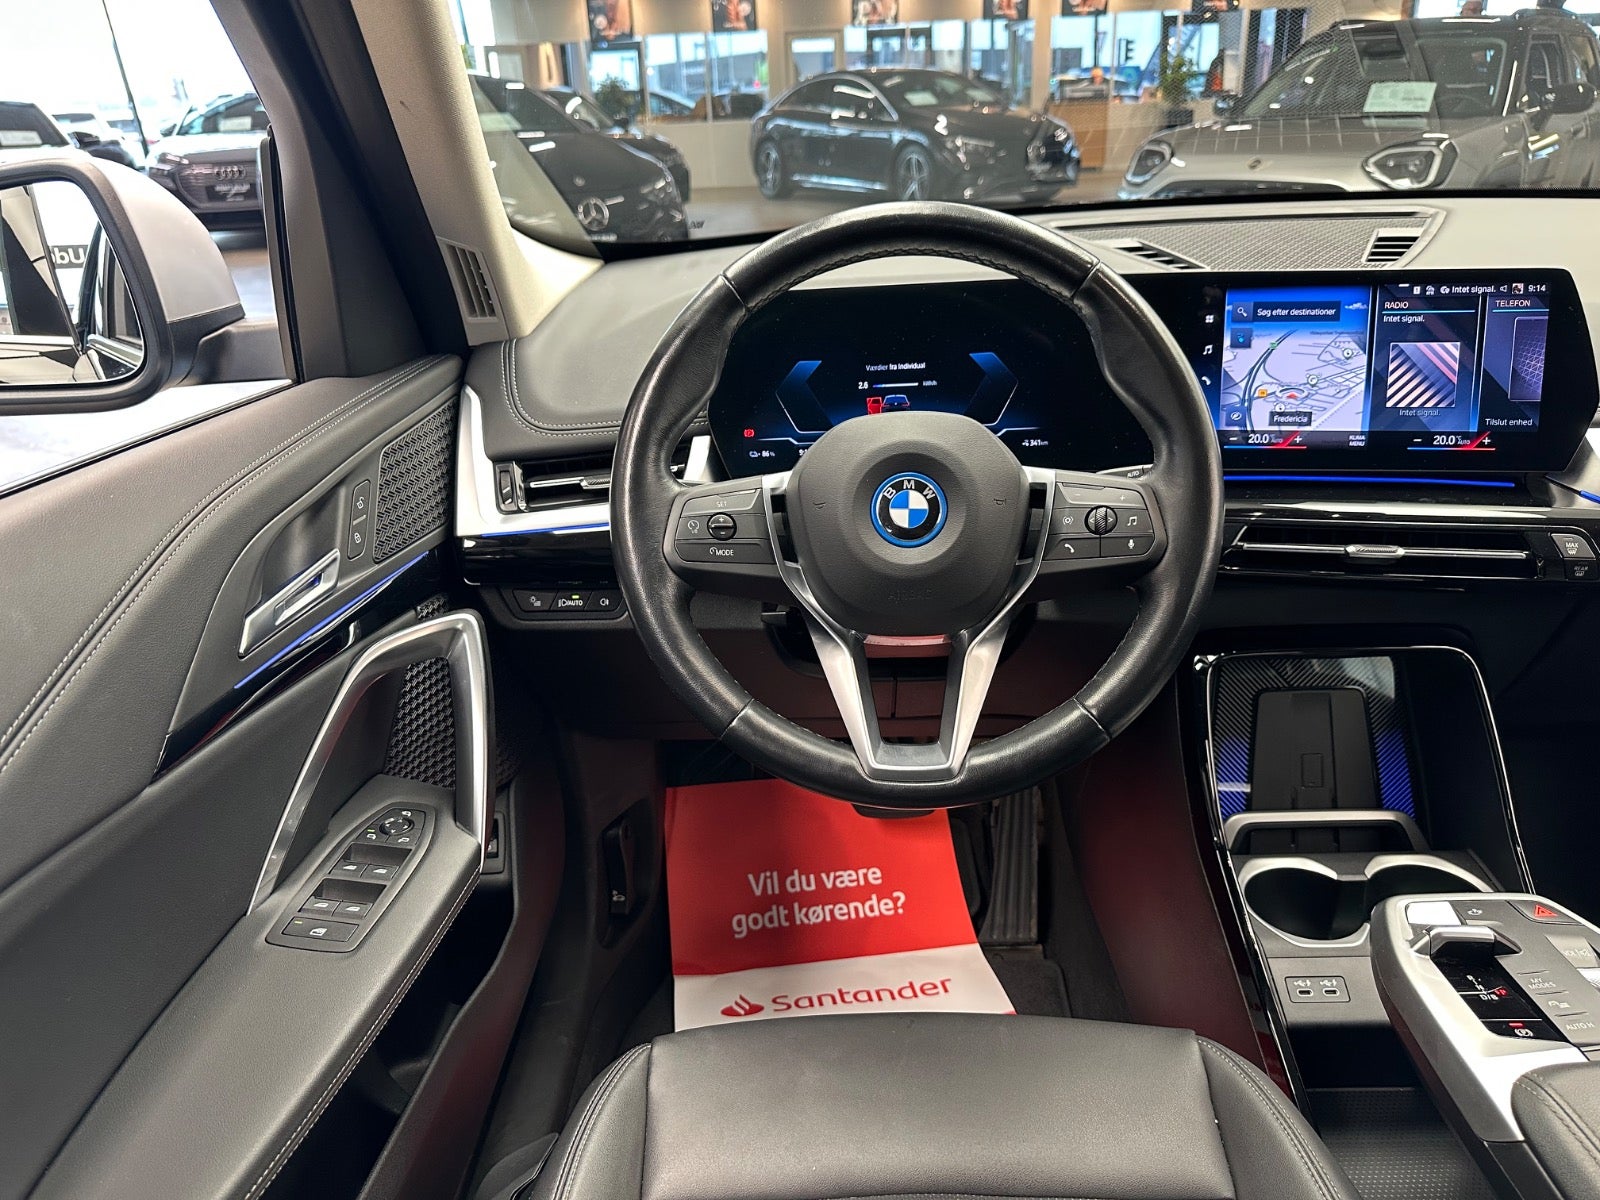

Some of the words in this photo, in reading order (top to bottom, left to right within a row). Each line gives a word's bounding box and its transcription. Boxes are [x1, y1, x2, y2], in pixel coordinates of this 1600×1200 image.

[1471, 286, 1496, 295] signal.
[1384, 301, 1409, 309] RADIO
[1257, 308, 1271, 317] Søg
[1272, 308, 1289, 316] efter
[1290, 308, 1336, 316] destinationer
[1401, 315, 1425, 324] signal.
[858, 381, 869, 390] 2.6
[1417, 409, 1441, 418] signal.
[1273, 415, 1308, 423] Fredericia
[1248, 434, 1269, 443] 20.0
[1433, 435, 1456, 445] 20.0
[883, 480, 936, 500] BMW
[748, 871, 779, 896] Vil
[785, 869, 815, 893] du
[821, 866, 882, 889] være
[731, 904, 789, 938] godt
[794, 891, 906, 925] kørende?
[771, 977, 952, 1012] Santander
[1566, 1022, 1585, 1030] AUTO
